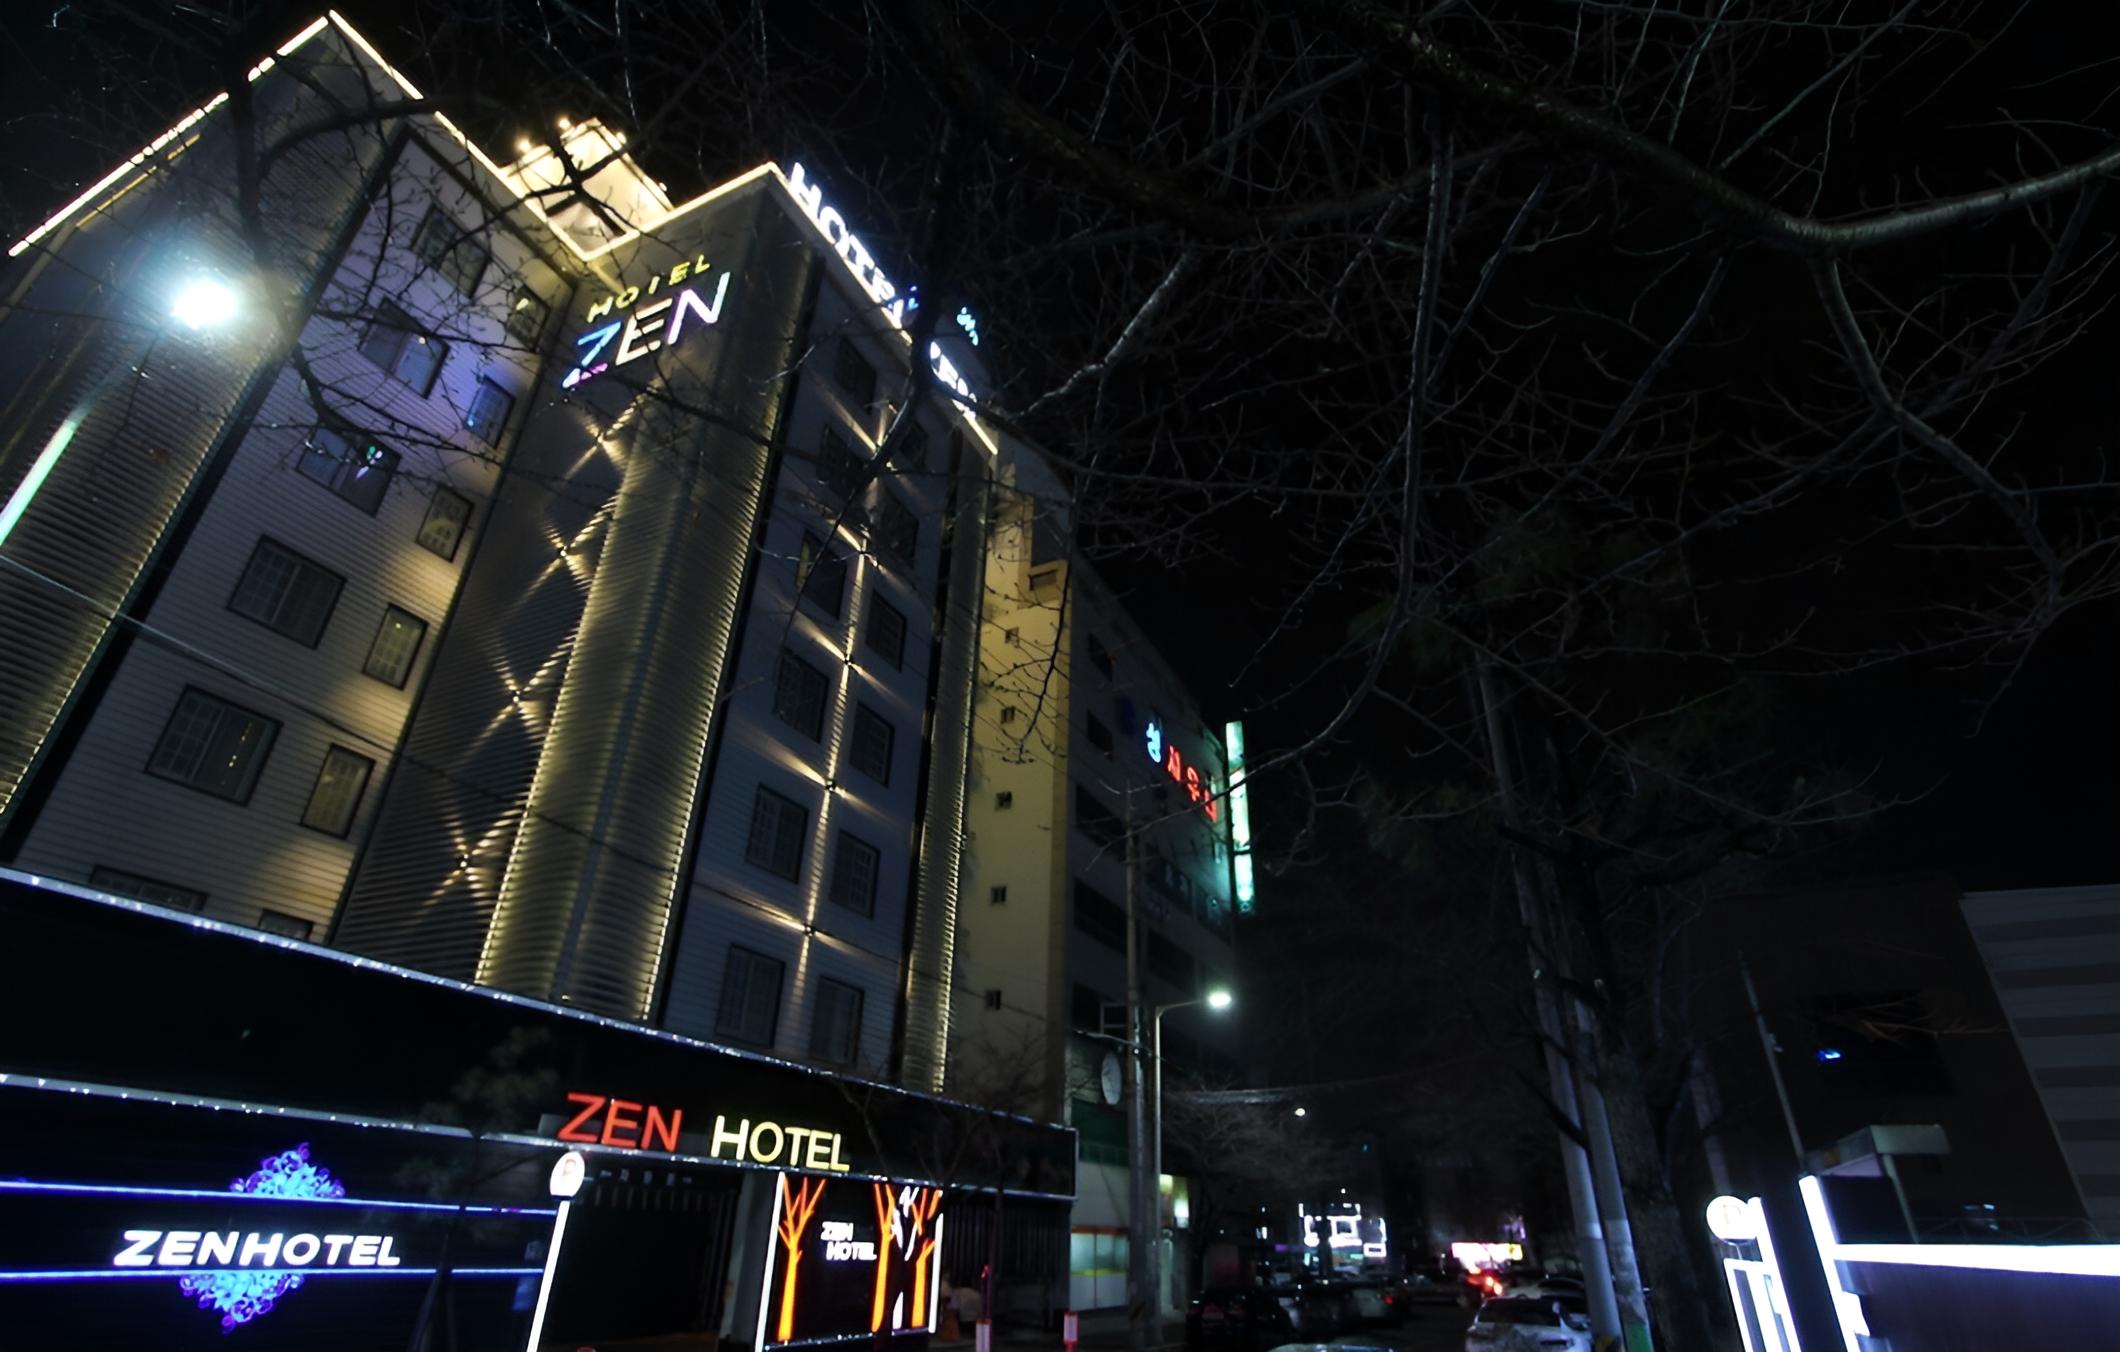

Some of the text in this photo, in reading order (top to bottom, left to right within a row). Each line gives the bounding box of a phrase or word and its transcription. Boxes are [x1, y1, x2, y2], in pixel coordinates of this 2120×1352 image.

[562, 271, 731, 388] ZEN
[558, 1092, 850, 1172] ZEN HOTEL
[113, 1230, 401, 1267] ZENHOTEL
[820, 1221, 854, 1241] ZEN
[826, 1241, 878, 1261] HOTEL
